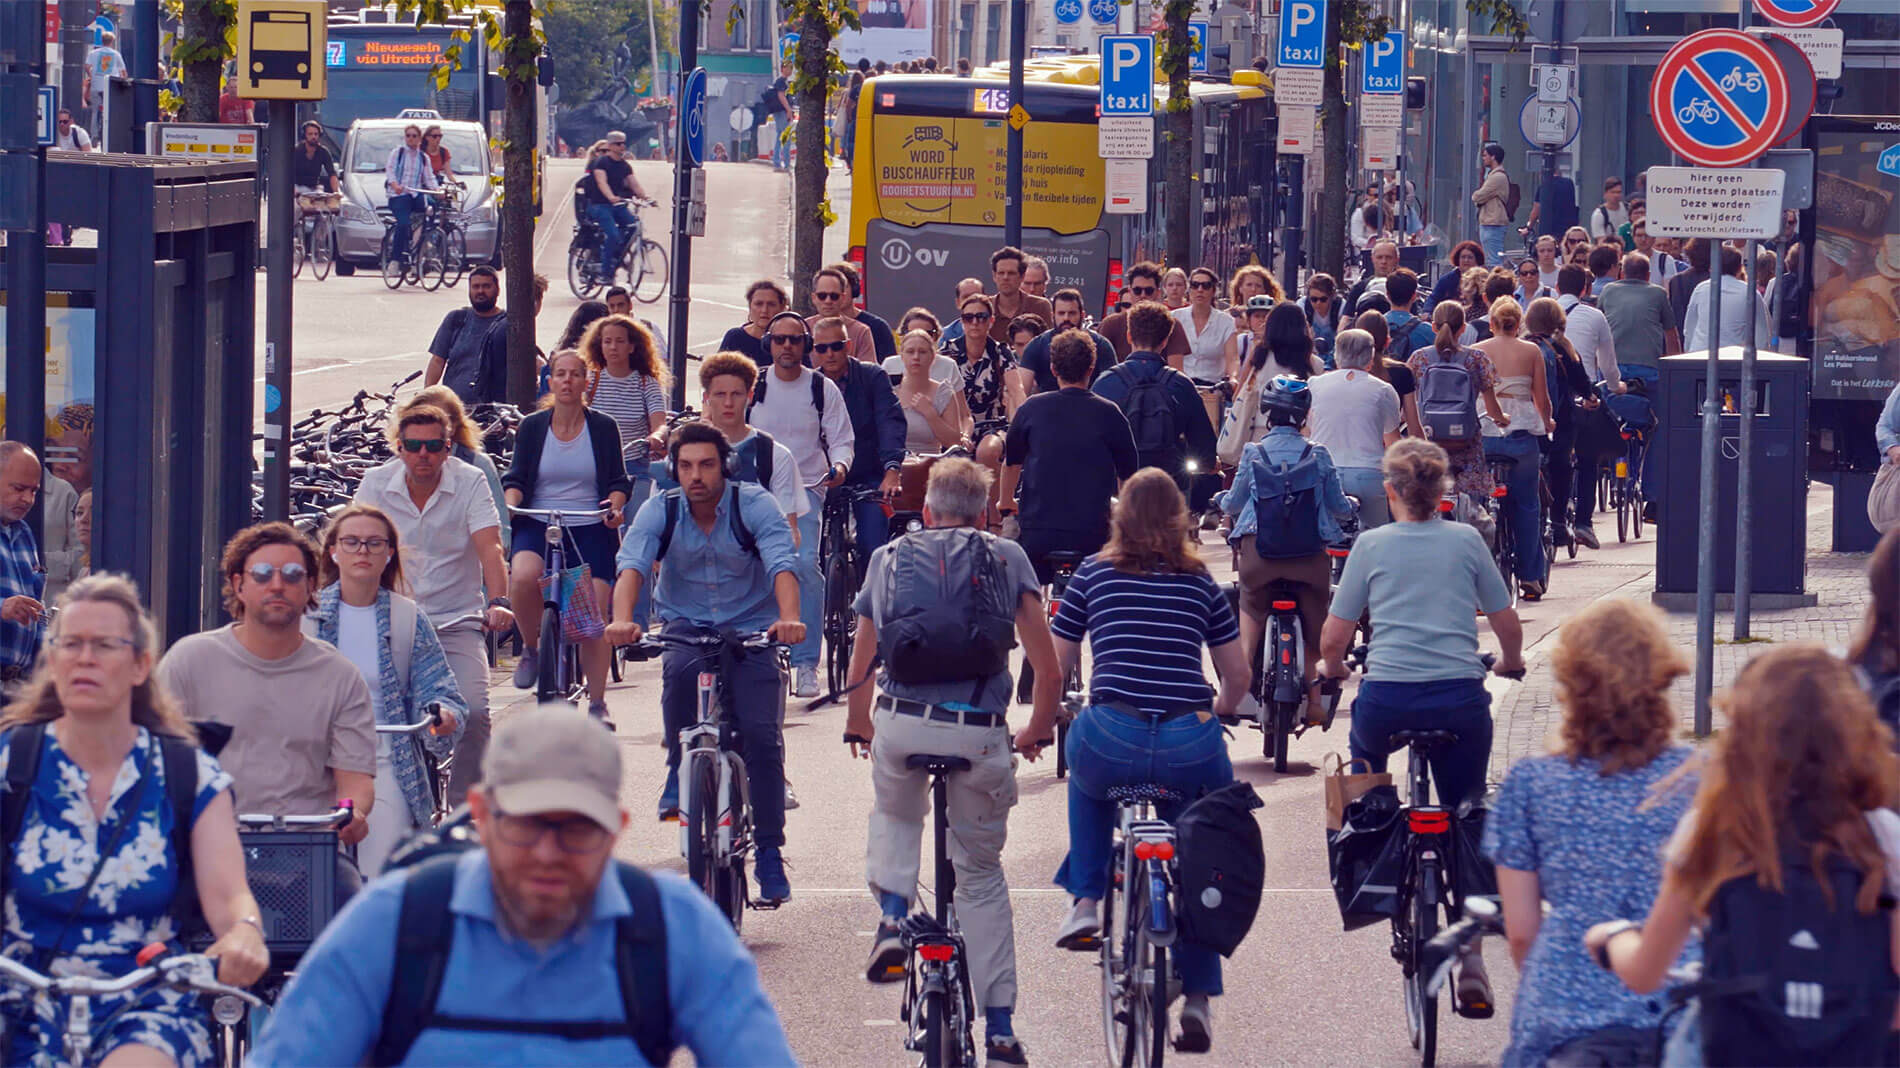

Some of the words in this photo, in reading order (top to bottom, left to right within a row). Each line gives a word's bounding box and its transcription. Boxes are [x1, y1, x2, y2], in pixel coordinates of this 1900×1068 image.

[1291, 3, 1316, 37] P
[1285, 45, 1319, 60] taxi
[1373, 38, 1395, 67] P
[356, 55, 378, 65] via
[382, 54, 432, 65] Utrecht
[1113, 43, 1141, 82] P
[1368, 74, 1399, 87] taxi
[982, 88, 1010, 110] 18
[1106, 93, 1147, 109] taxi
[1017, 113, 1023, 121] 3
[910, 150, 945, 163] WORD
[883, 166, 975, 180] BUSCHAUFFEUR
[1036, 164, 1085, 177] rijopleiding
[1031, 178, 1048, 188] huis
[1690, 174, 1713, 182] hier
[1717, 175, 1743, 184] geen
[1650, 186, 1727, 196] (brom)fietsen
[1034, 192, 1070, 203] flexibele
[1072, 194, 1097, 206] tijden
[1681, 199, 1708, 208] Deze
[1711, 200, 1751, 209] worden
[1054, 275, 1066, 284] 52
[1068, 276, 1086, 286] 241
